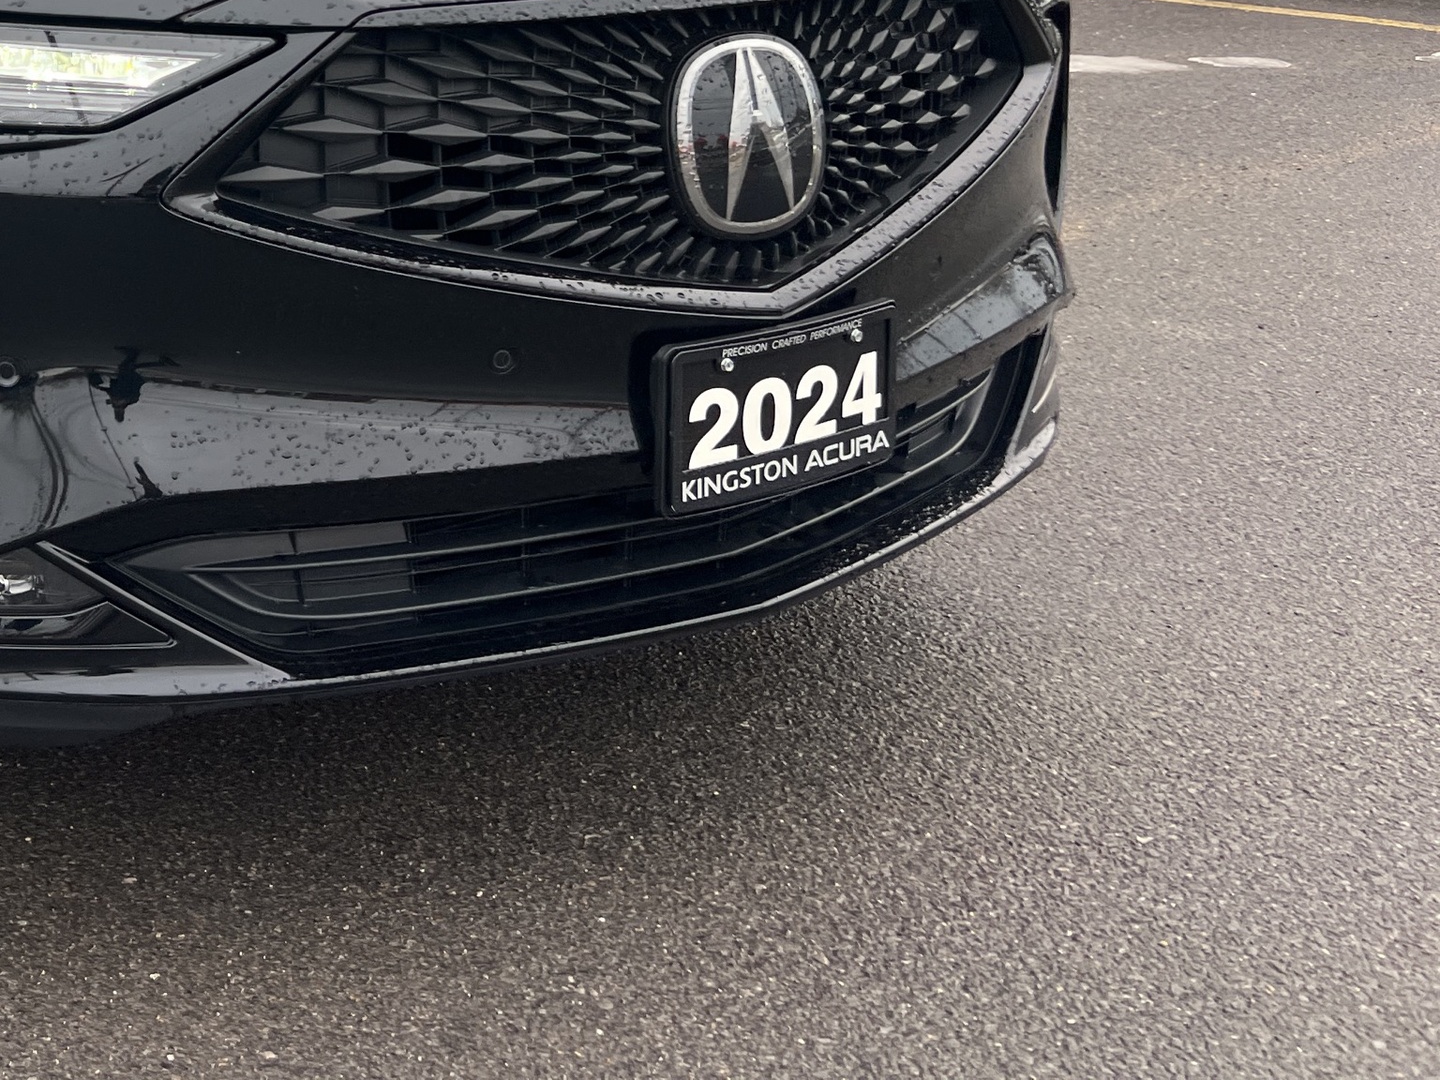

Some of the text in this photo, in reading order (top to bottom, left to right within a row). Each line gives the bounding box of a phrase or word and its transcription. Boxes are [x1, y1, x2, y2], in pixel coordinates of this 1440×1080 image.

[722, 318, 863, 358] PRECISION CRAFTED PERFORMANCE
[688, 351, 882, 470] 2024
[681, 430, 890, 503] KINGSTON ACURA
